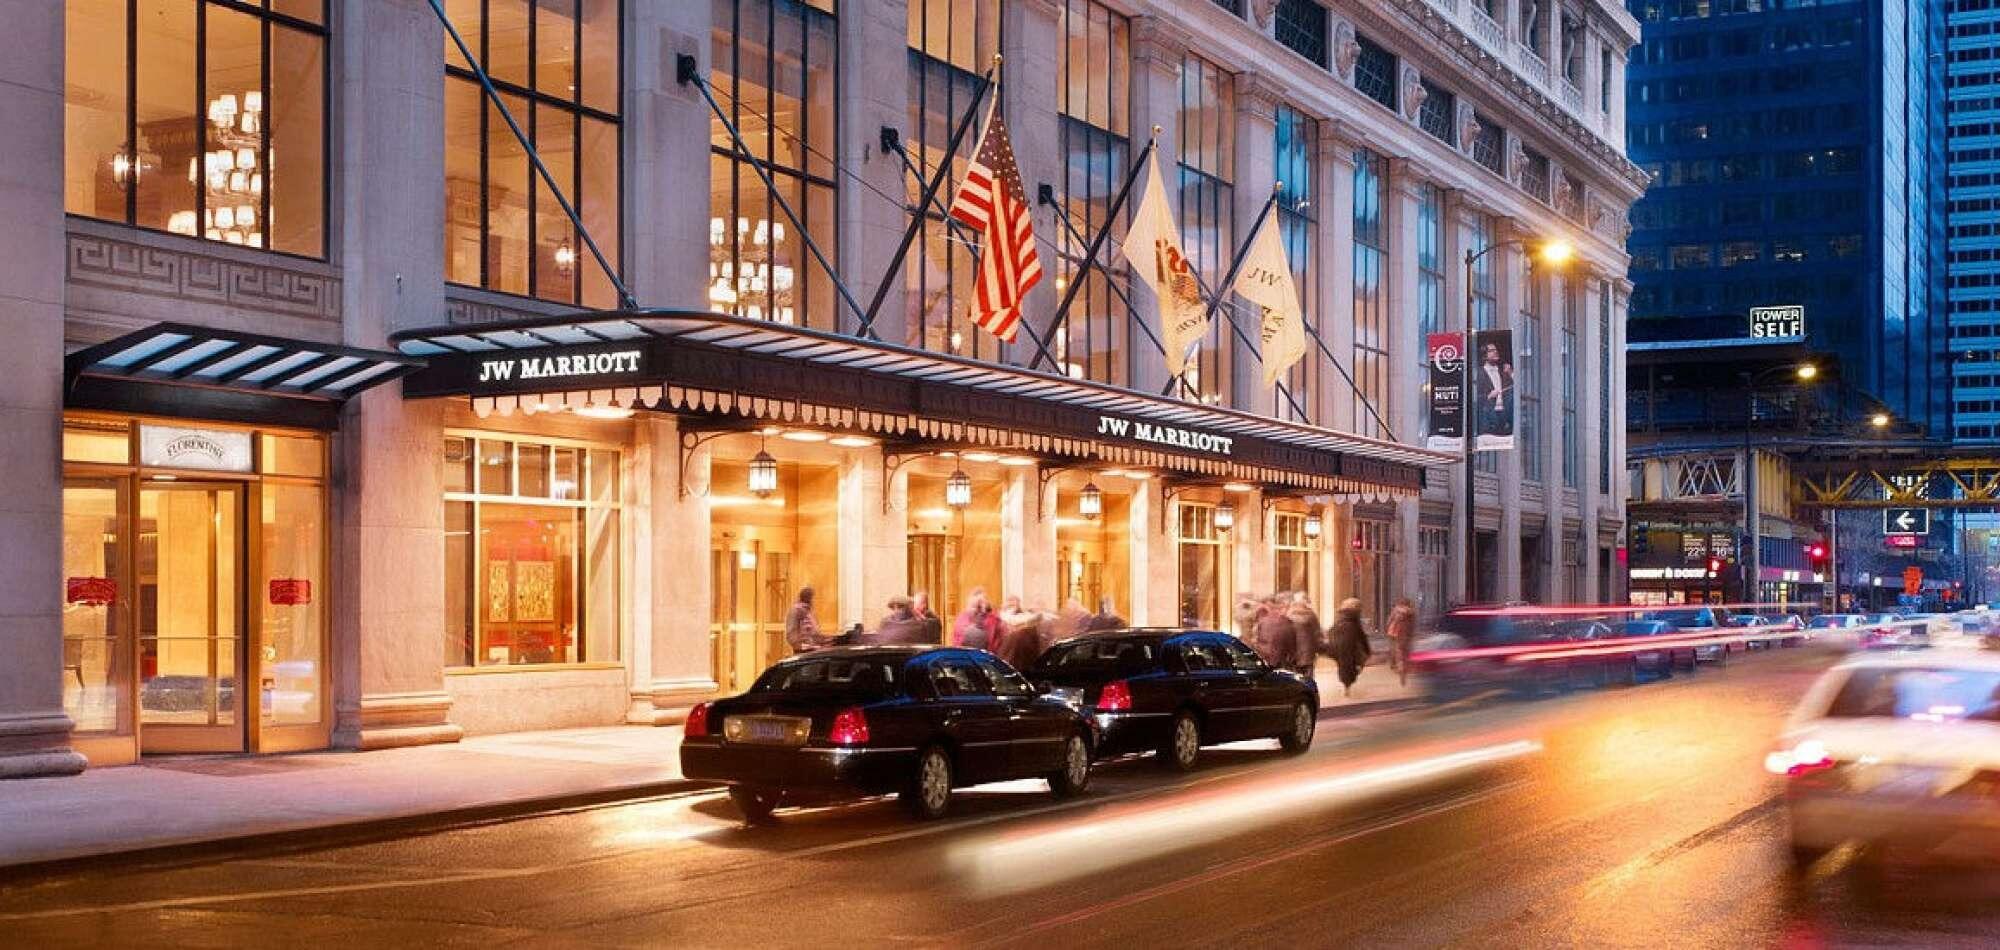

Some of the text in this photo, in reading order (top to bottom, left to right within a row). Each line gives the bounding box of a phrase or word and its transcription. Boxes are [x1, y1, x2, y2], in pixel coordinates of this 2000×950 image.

[1753, 309, 1800, 322] TOWER
[1753, 320, 1800, 338] SELF
[479, 350, 641, 381] JW MARRIOTT
[1098, 415, 1233, 455] JW MARRIOTT
